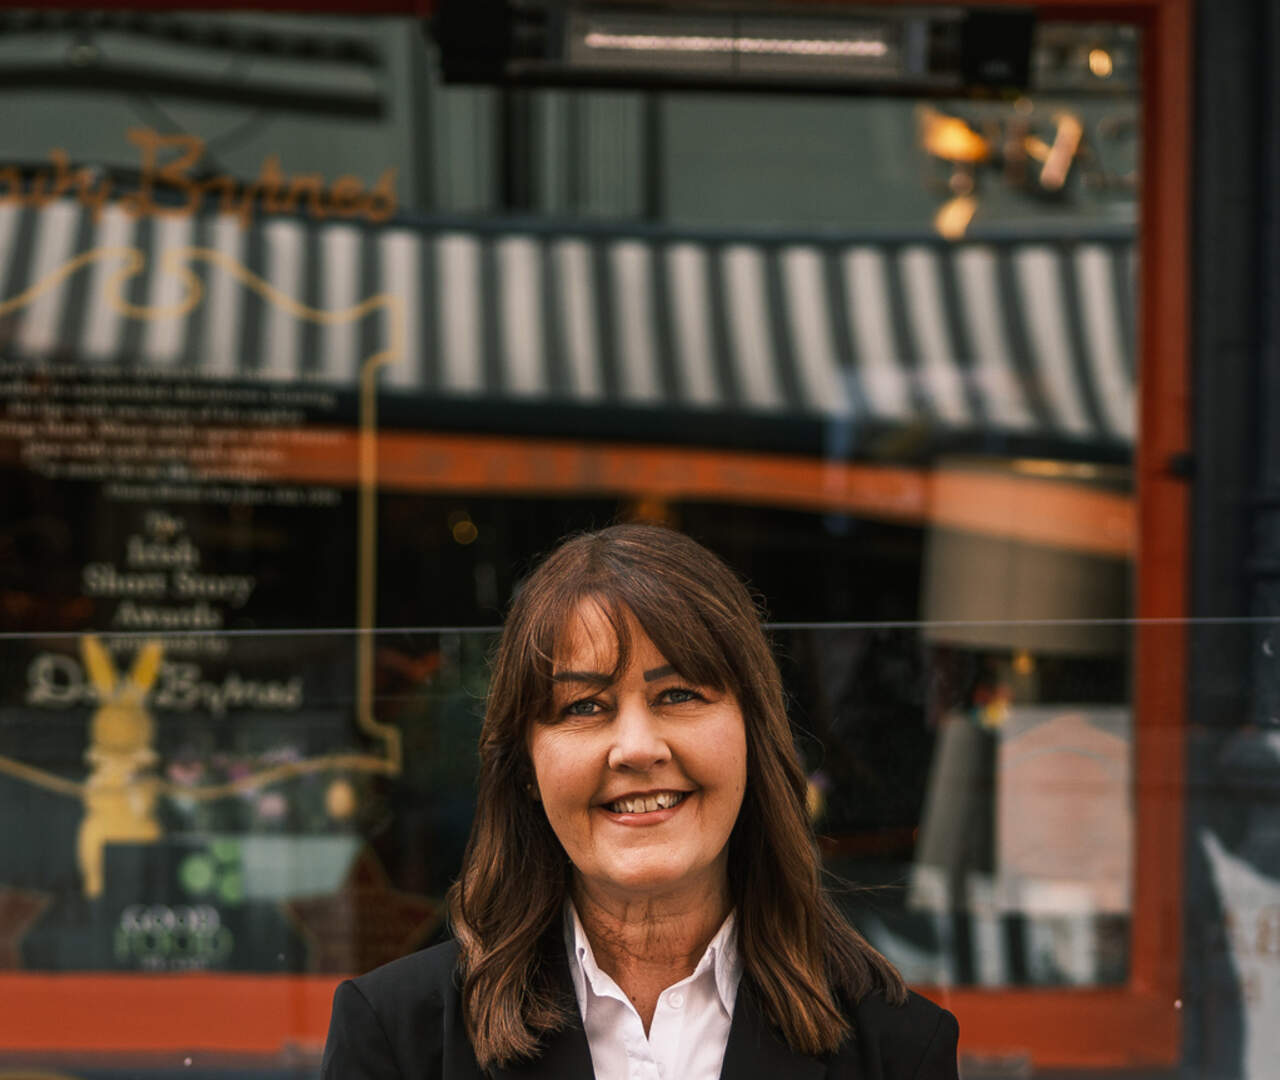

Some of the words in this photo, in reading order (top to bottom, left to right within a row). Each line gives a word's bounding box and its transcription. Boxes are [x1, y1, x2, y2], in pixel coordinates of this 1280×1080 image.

[122, 126, 400, 229] Byrnes
[126, 534, 198, 568] Irish
[83, 563, 167, 598] Short
[173, 571, 256, 610] Story
[114, 600, 222, 630] Awards
[154, 659, 303, 716] Byrnes
